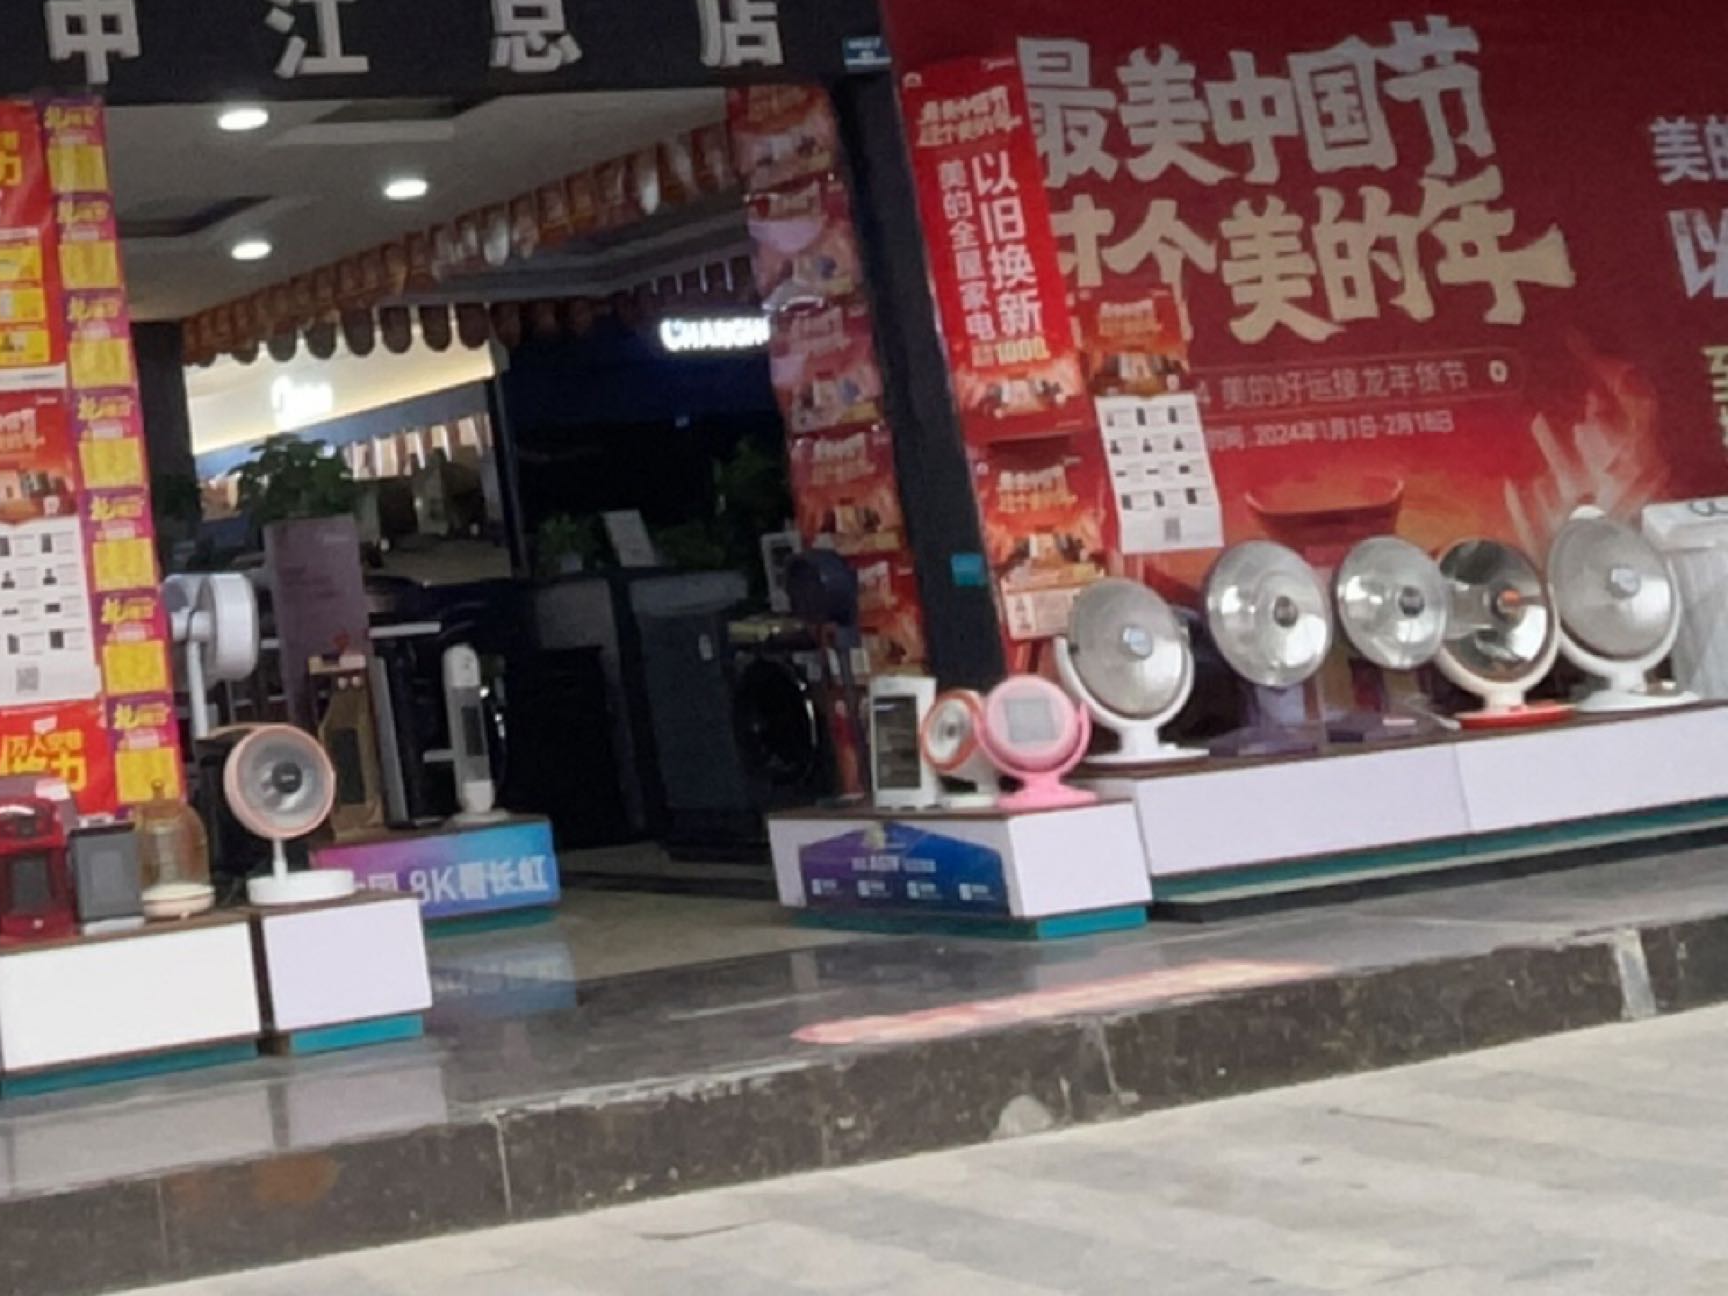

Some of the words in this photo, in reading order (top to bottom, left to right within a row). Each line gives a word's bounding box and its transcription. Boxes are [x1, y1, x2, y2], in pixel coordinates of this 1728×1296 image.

[1017, 15, 1495, 188] 最美中国节
[972, 150, 1043, 337] 以旧换新
